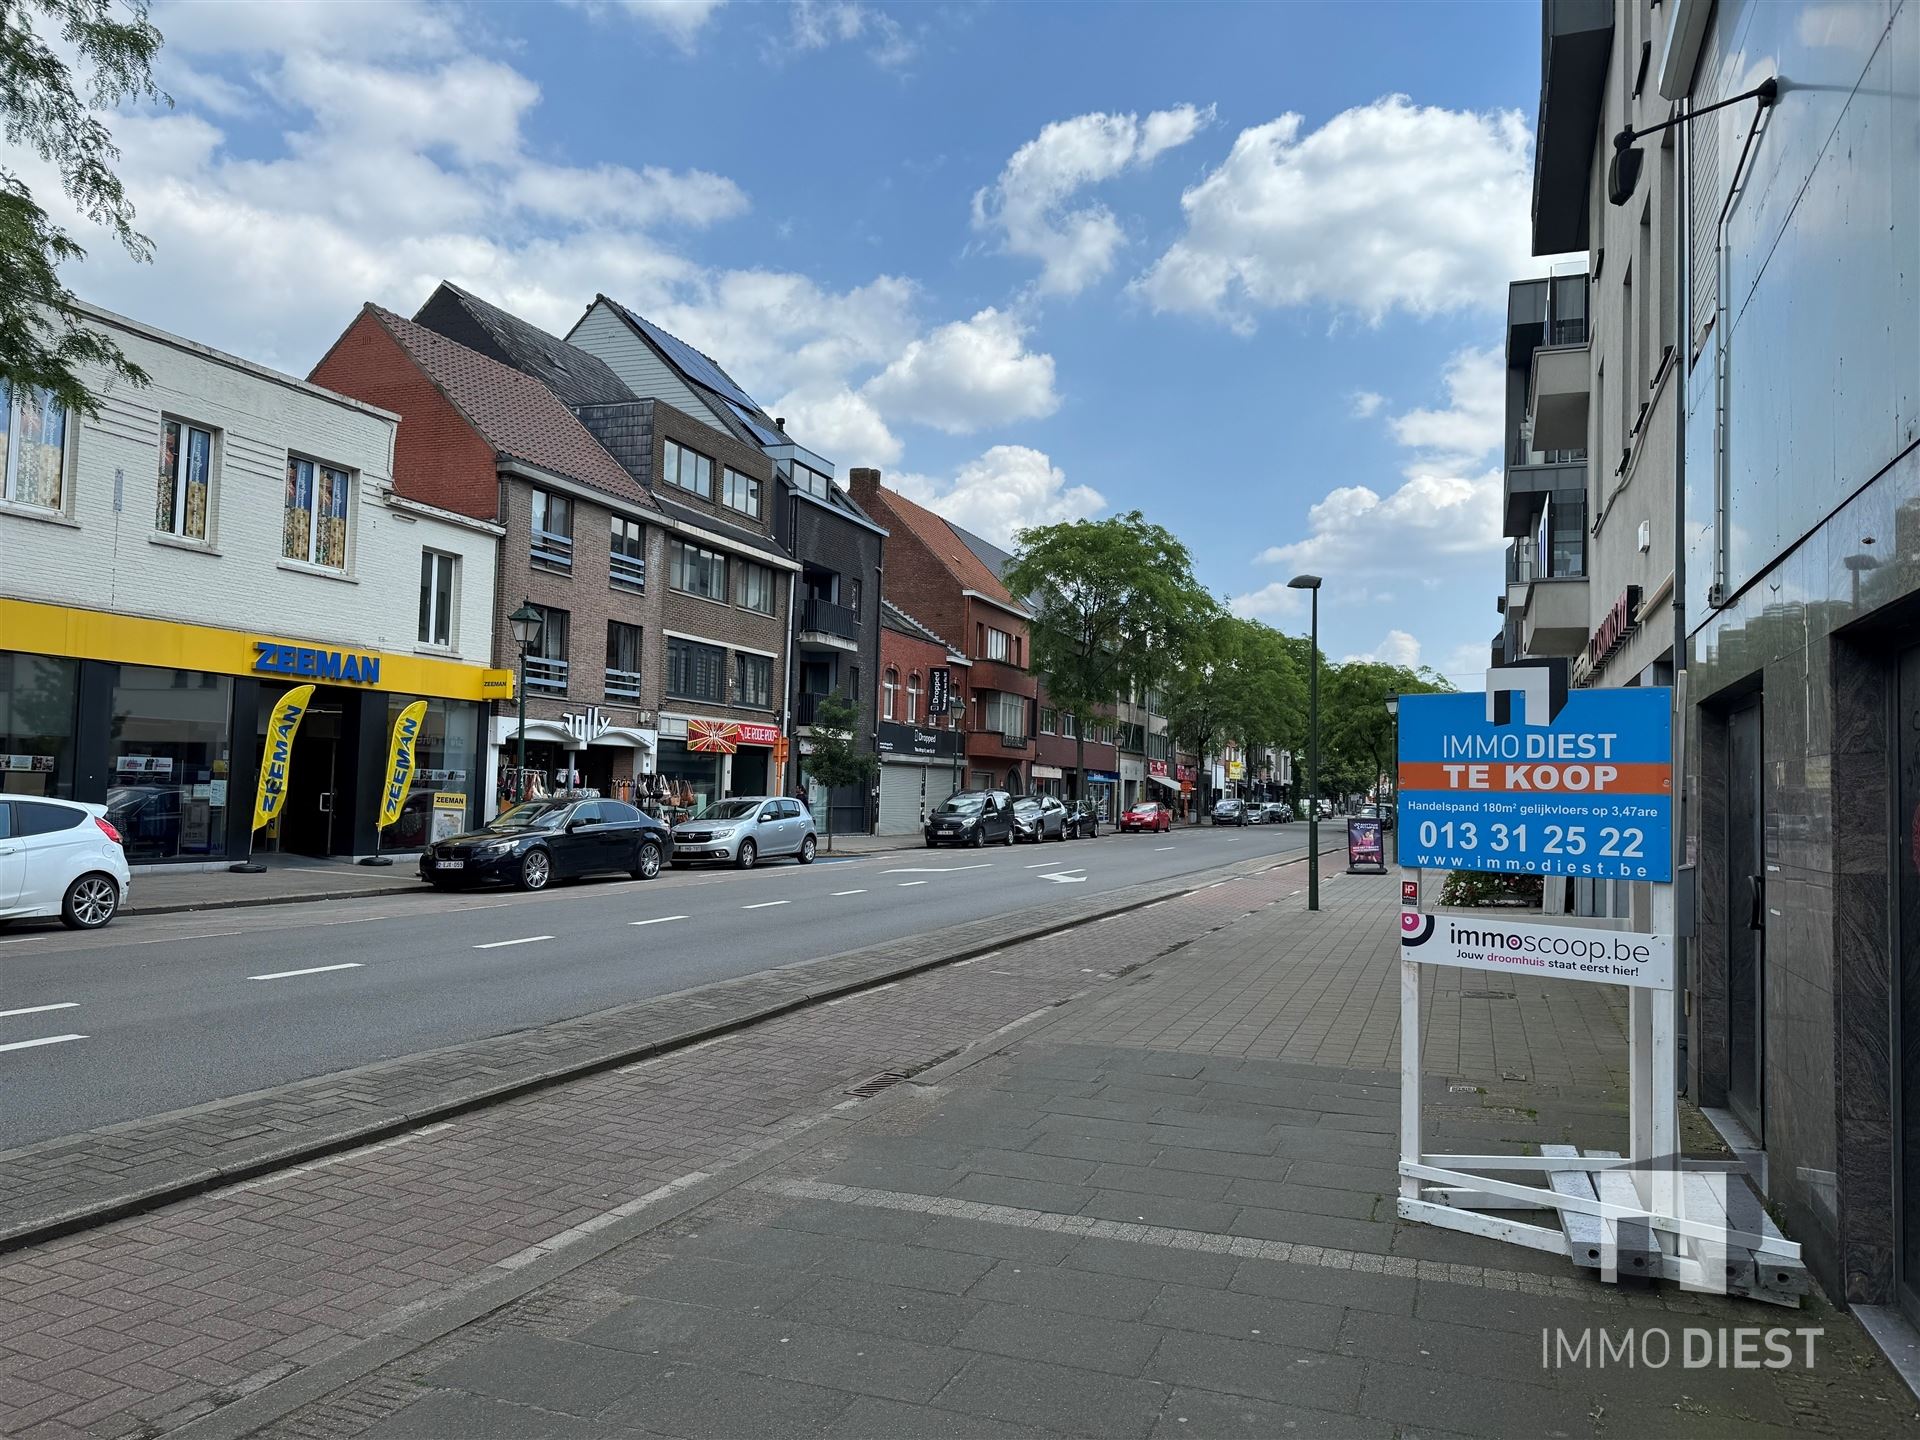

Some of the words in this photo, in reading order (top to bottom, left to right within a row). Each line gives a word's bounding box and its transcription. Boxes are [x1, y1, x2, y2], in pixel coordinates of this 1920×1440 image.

[254, 641, 381, 684] ZEEMAN
[932, 671, 941, 704] Dropped
[744, 727, 751, 739] DE
[752, 728, 764, 741] RODE
[1443, 734, 1519, 759] IMMO
[1526, 733, 1617, 759] DIEST
[262, 704, 302, 813] ZEEMAN
[386, 717, 418, 815] ZEEMAN
[1442, 764, 1490, 789] TE
[1505, 765, 1618, 791] KOOP
[436, 797, 464, 805] ZEEMAN
[1408, 801, 1479, 814] Handelspand
[1483, 802, 1517, 813] 180m²
[1520, 803, 1588, 816] gelijkvloers
[1592, 807, 1608, 818] op
[1611, 806, 1658, 818] 3,47are
[1419, 821, 1478, 850] 013
[1490, 823, 1527, 852] 31
[1543, 825, 1586, 855] 25
[1599, 827, 1644, 858] 22
[1450, 922, 1650, 963] immoscoop.be
[1456, 949, 1484, 961] Jouw
[1487, 953, 1545, 967] droomhuis
[1548, 960, 1577, 971] staat
[1580, 963, 1609, 974] eerst
[1612, 965, 1639, 977] hier!
